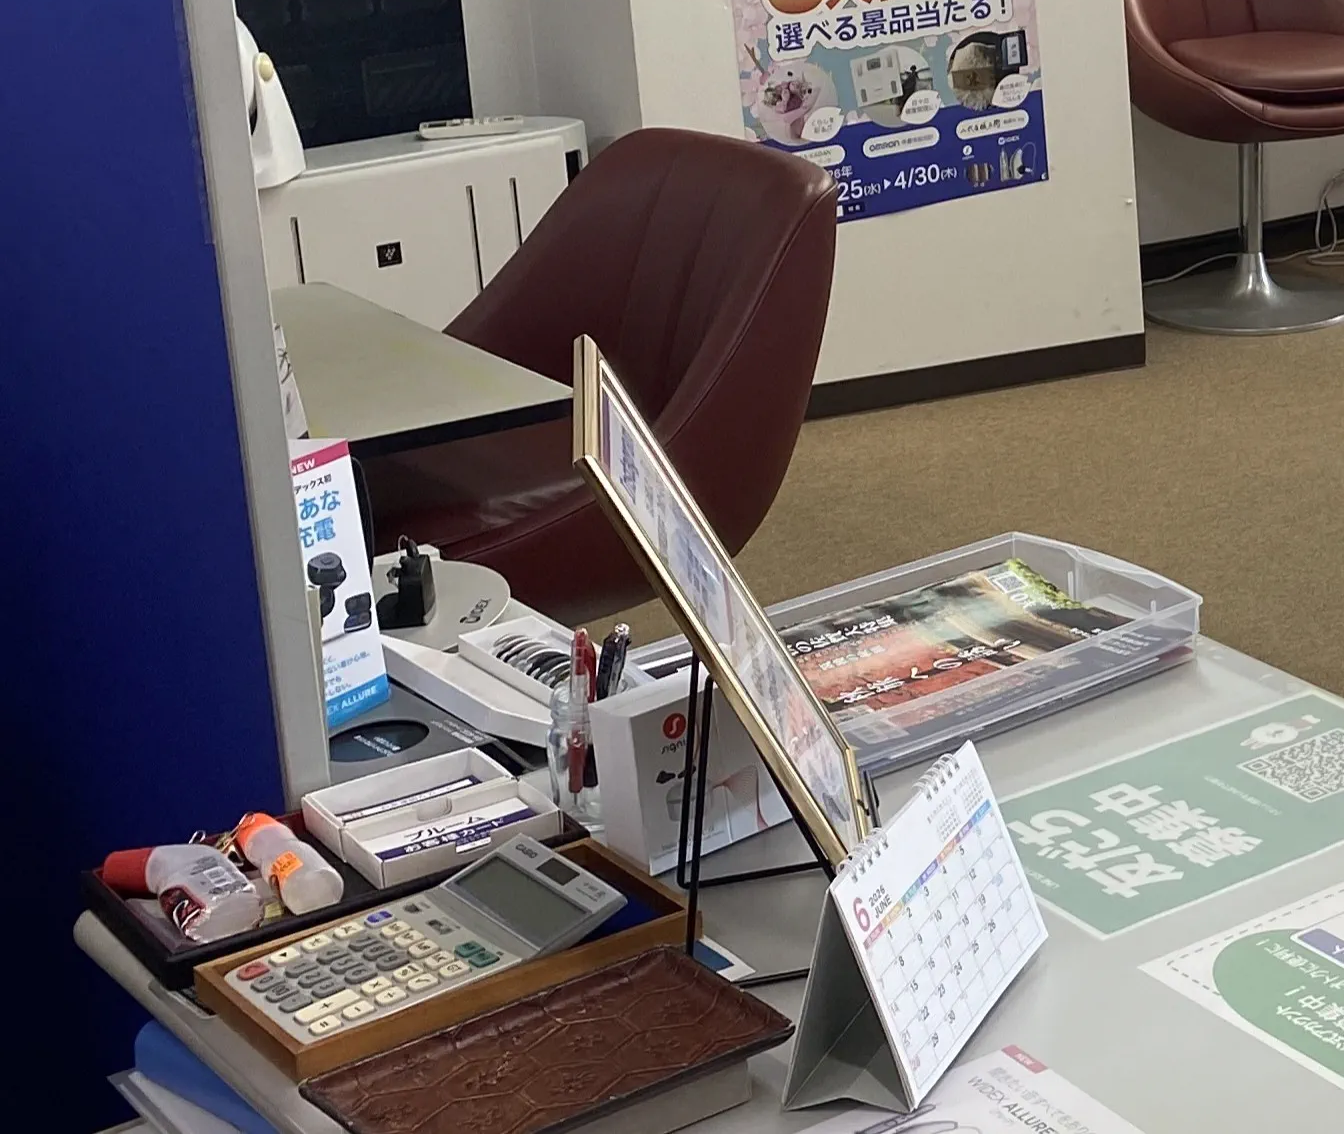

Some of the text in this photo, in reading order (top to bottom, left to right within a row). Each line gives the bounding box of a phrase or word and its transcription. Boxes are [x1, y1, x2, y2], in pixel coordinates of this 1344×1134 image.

[298, 489, 341, 521] あな
[341, 685, 377, 709] ALLURE
[1088, 782, 1264, 867] 募集中
[515, 842, 539, 860] CASIO
[1008, 807, 1185, 899] 友だち
[853, 884, 887, 933] 6 2026
[873, 894, 894, 919] JUNE
[967, 1075, 1009, 1105] WIDEX
